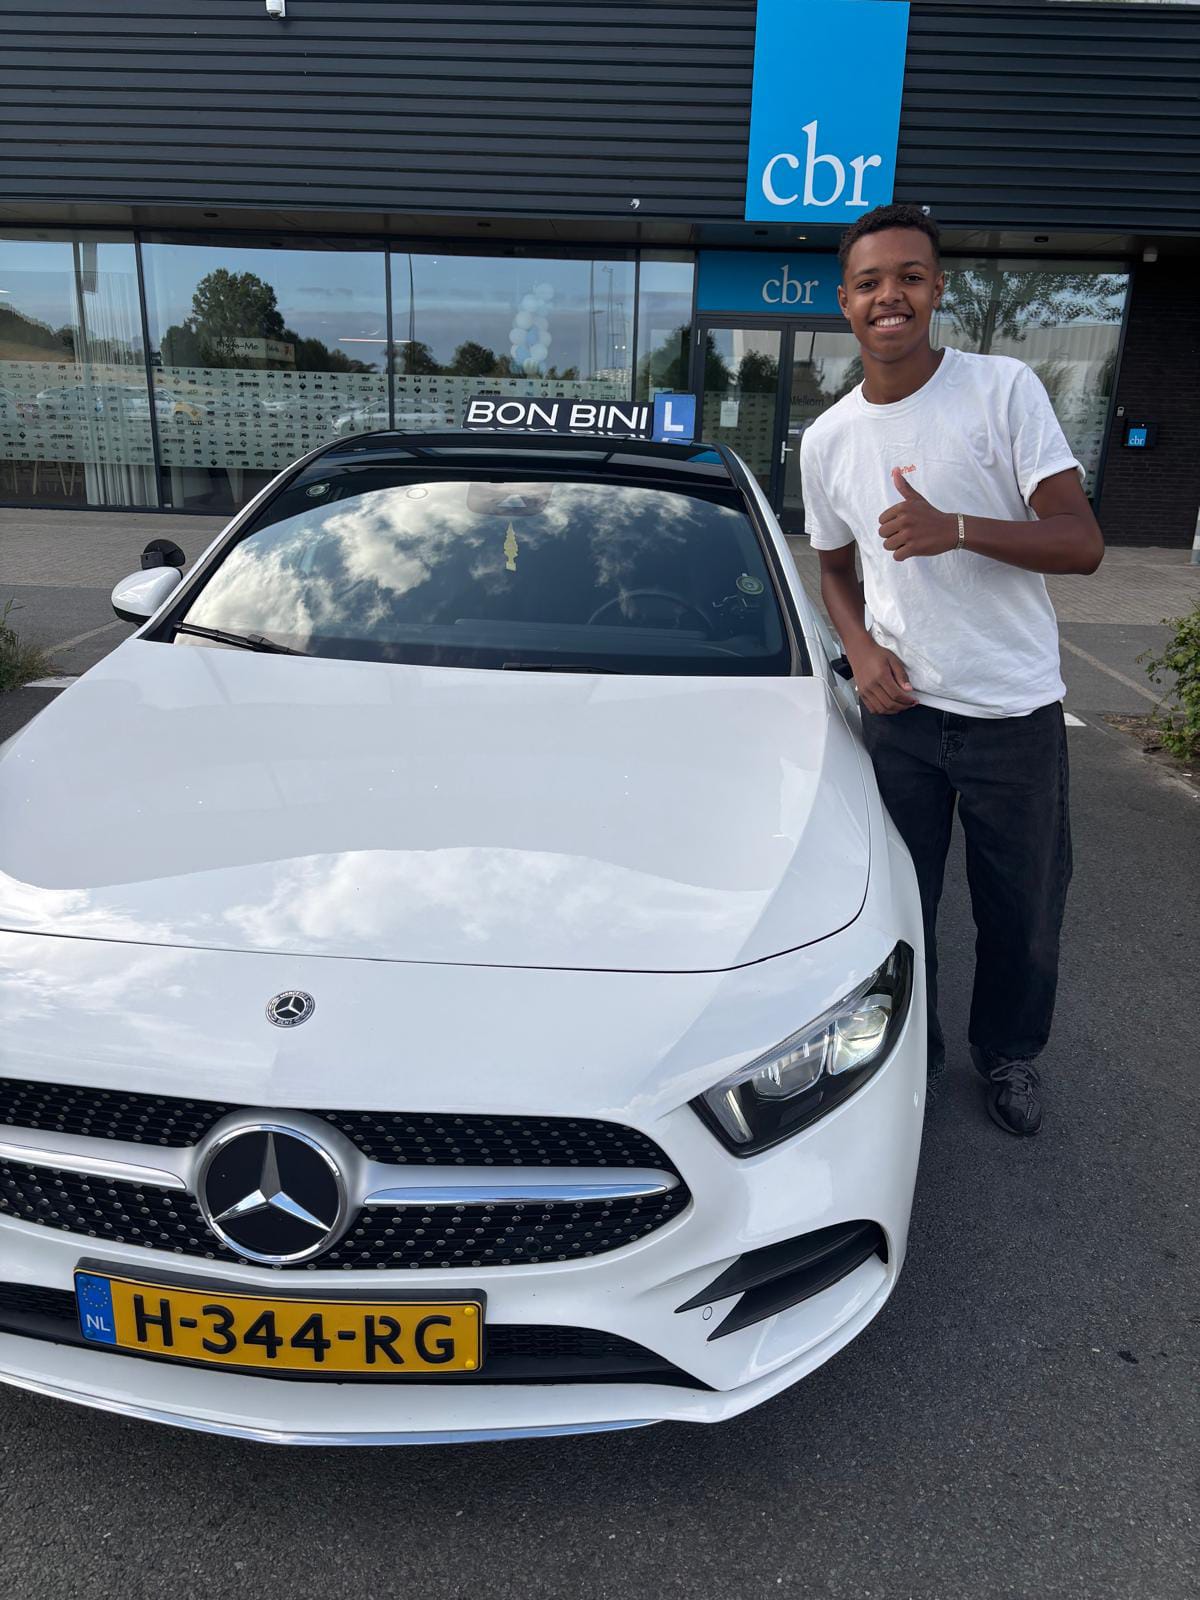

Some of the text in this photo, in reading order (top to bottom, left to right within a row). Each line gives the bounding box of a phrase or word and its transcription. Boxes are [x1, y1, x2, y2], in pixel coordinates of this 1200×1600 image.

[762, 119, 882, 207] cbr
[762, 264, 819, 304] cbr
[467, 401, 649, 430] BON BINI
[663, 401, 684, 432] L
[1129, 434, 1145, 446] cbr
[86, 1313, 111, 1332] NL
[133, 1294, 455, 1365] H-344-RG
